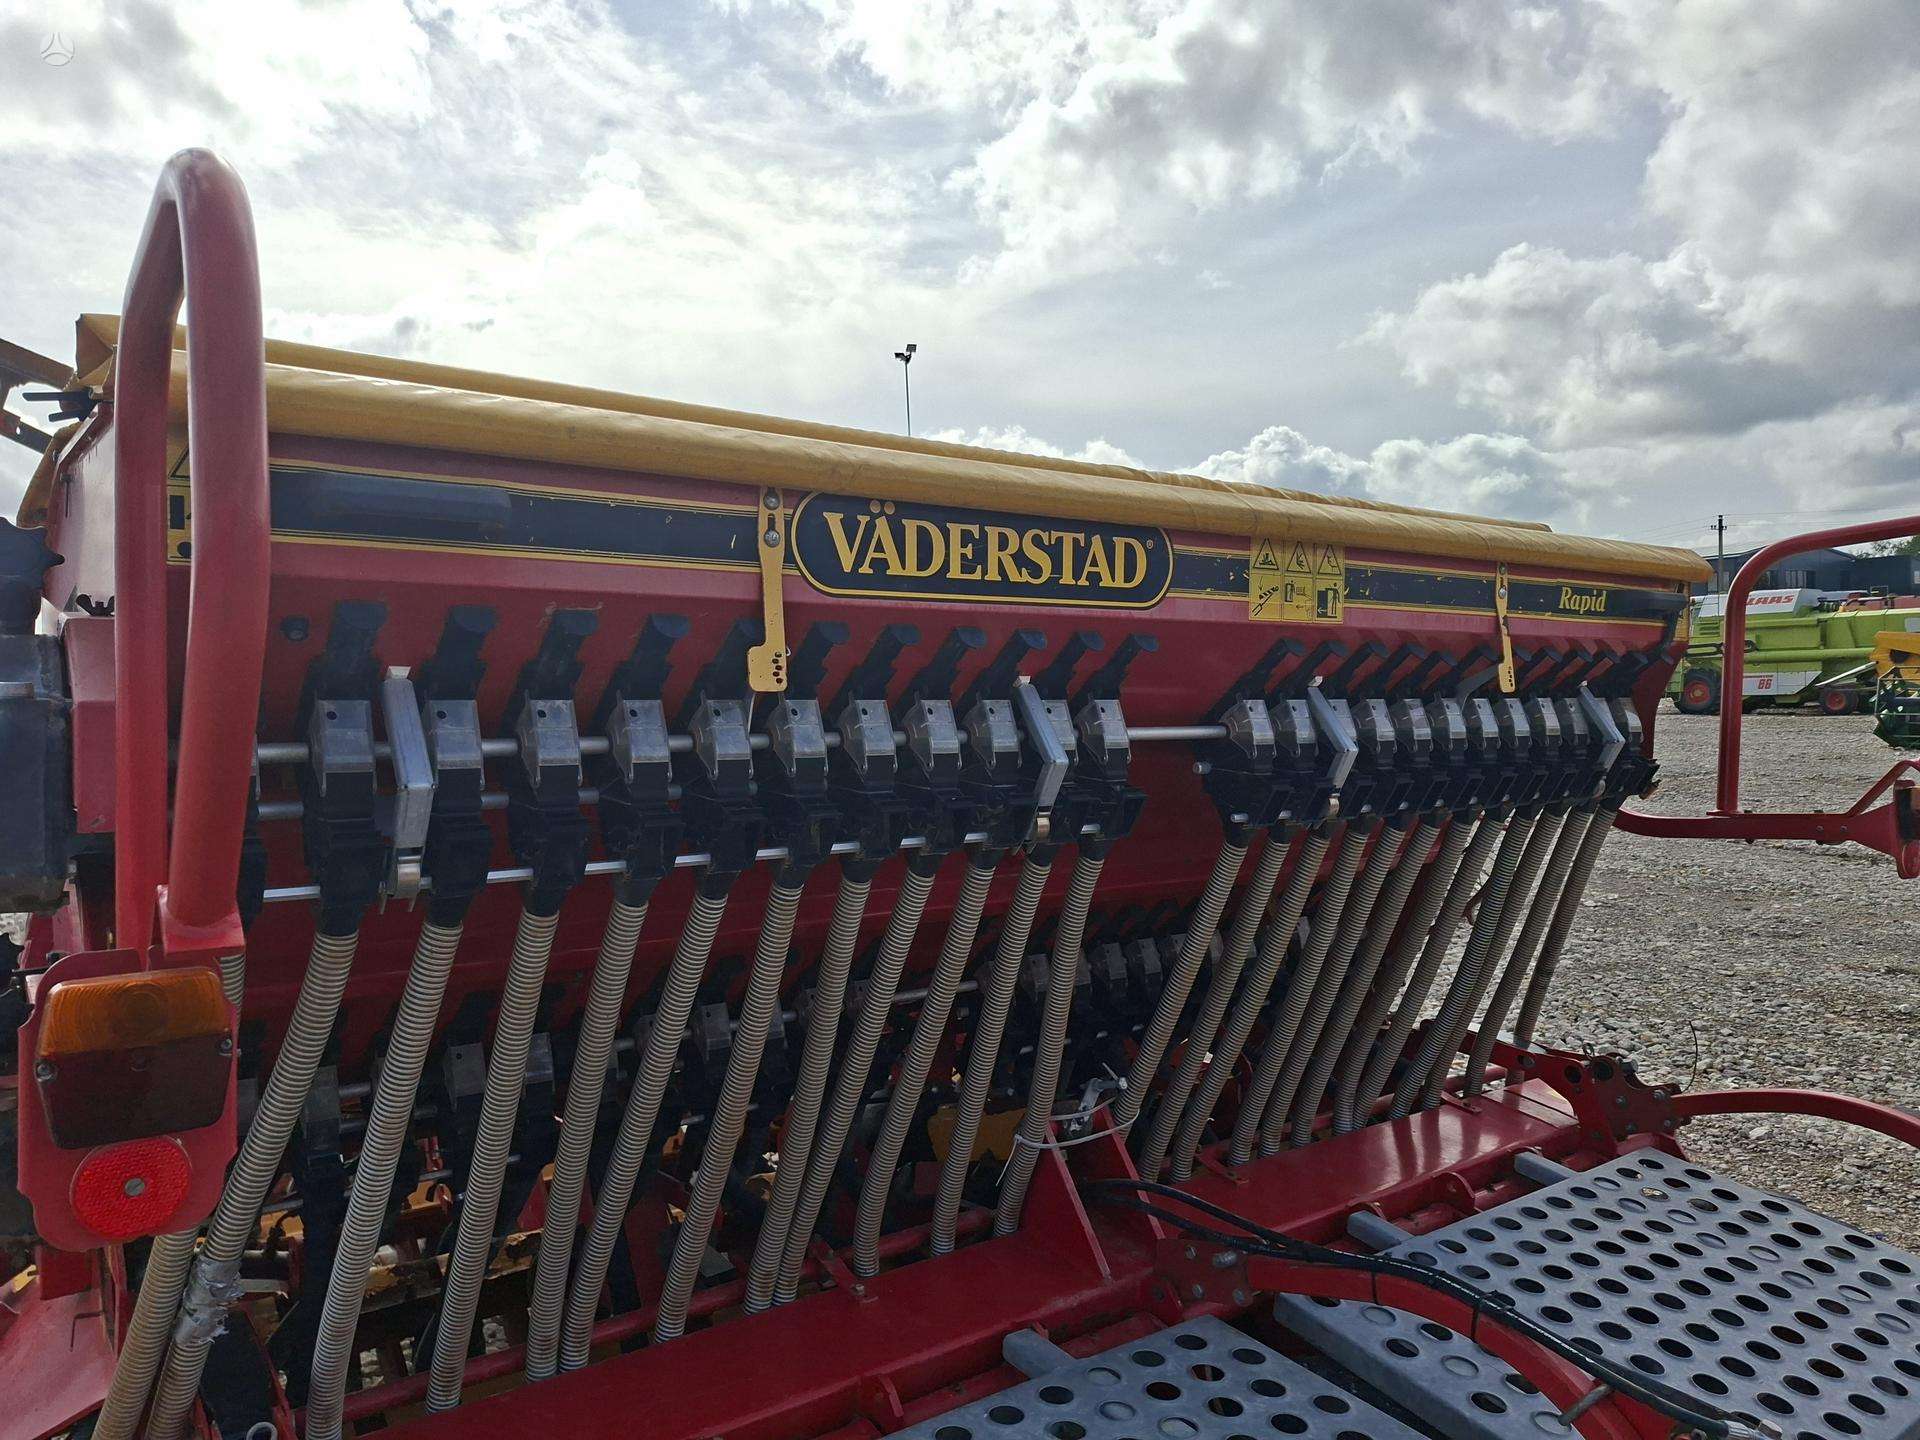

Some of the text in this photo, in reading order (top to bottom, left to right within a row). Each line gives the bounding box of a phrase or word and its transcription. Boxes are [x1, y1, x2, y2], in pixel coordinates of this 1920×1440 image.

[822, 500, 1148, 589] VÄDERSTAD
[1558, 586, 1608, 615] Rapid
[1745, 595, 1795, 606] LAAS
